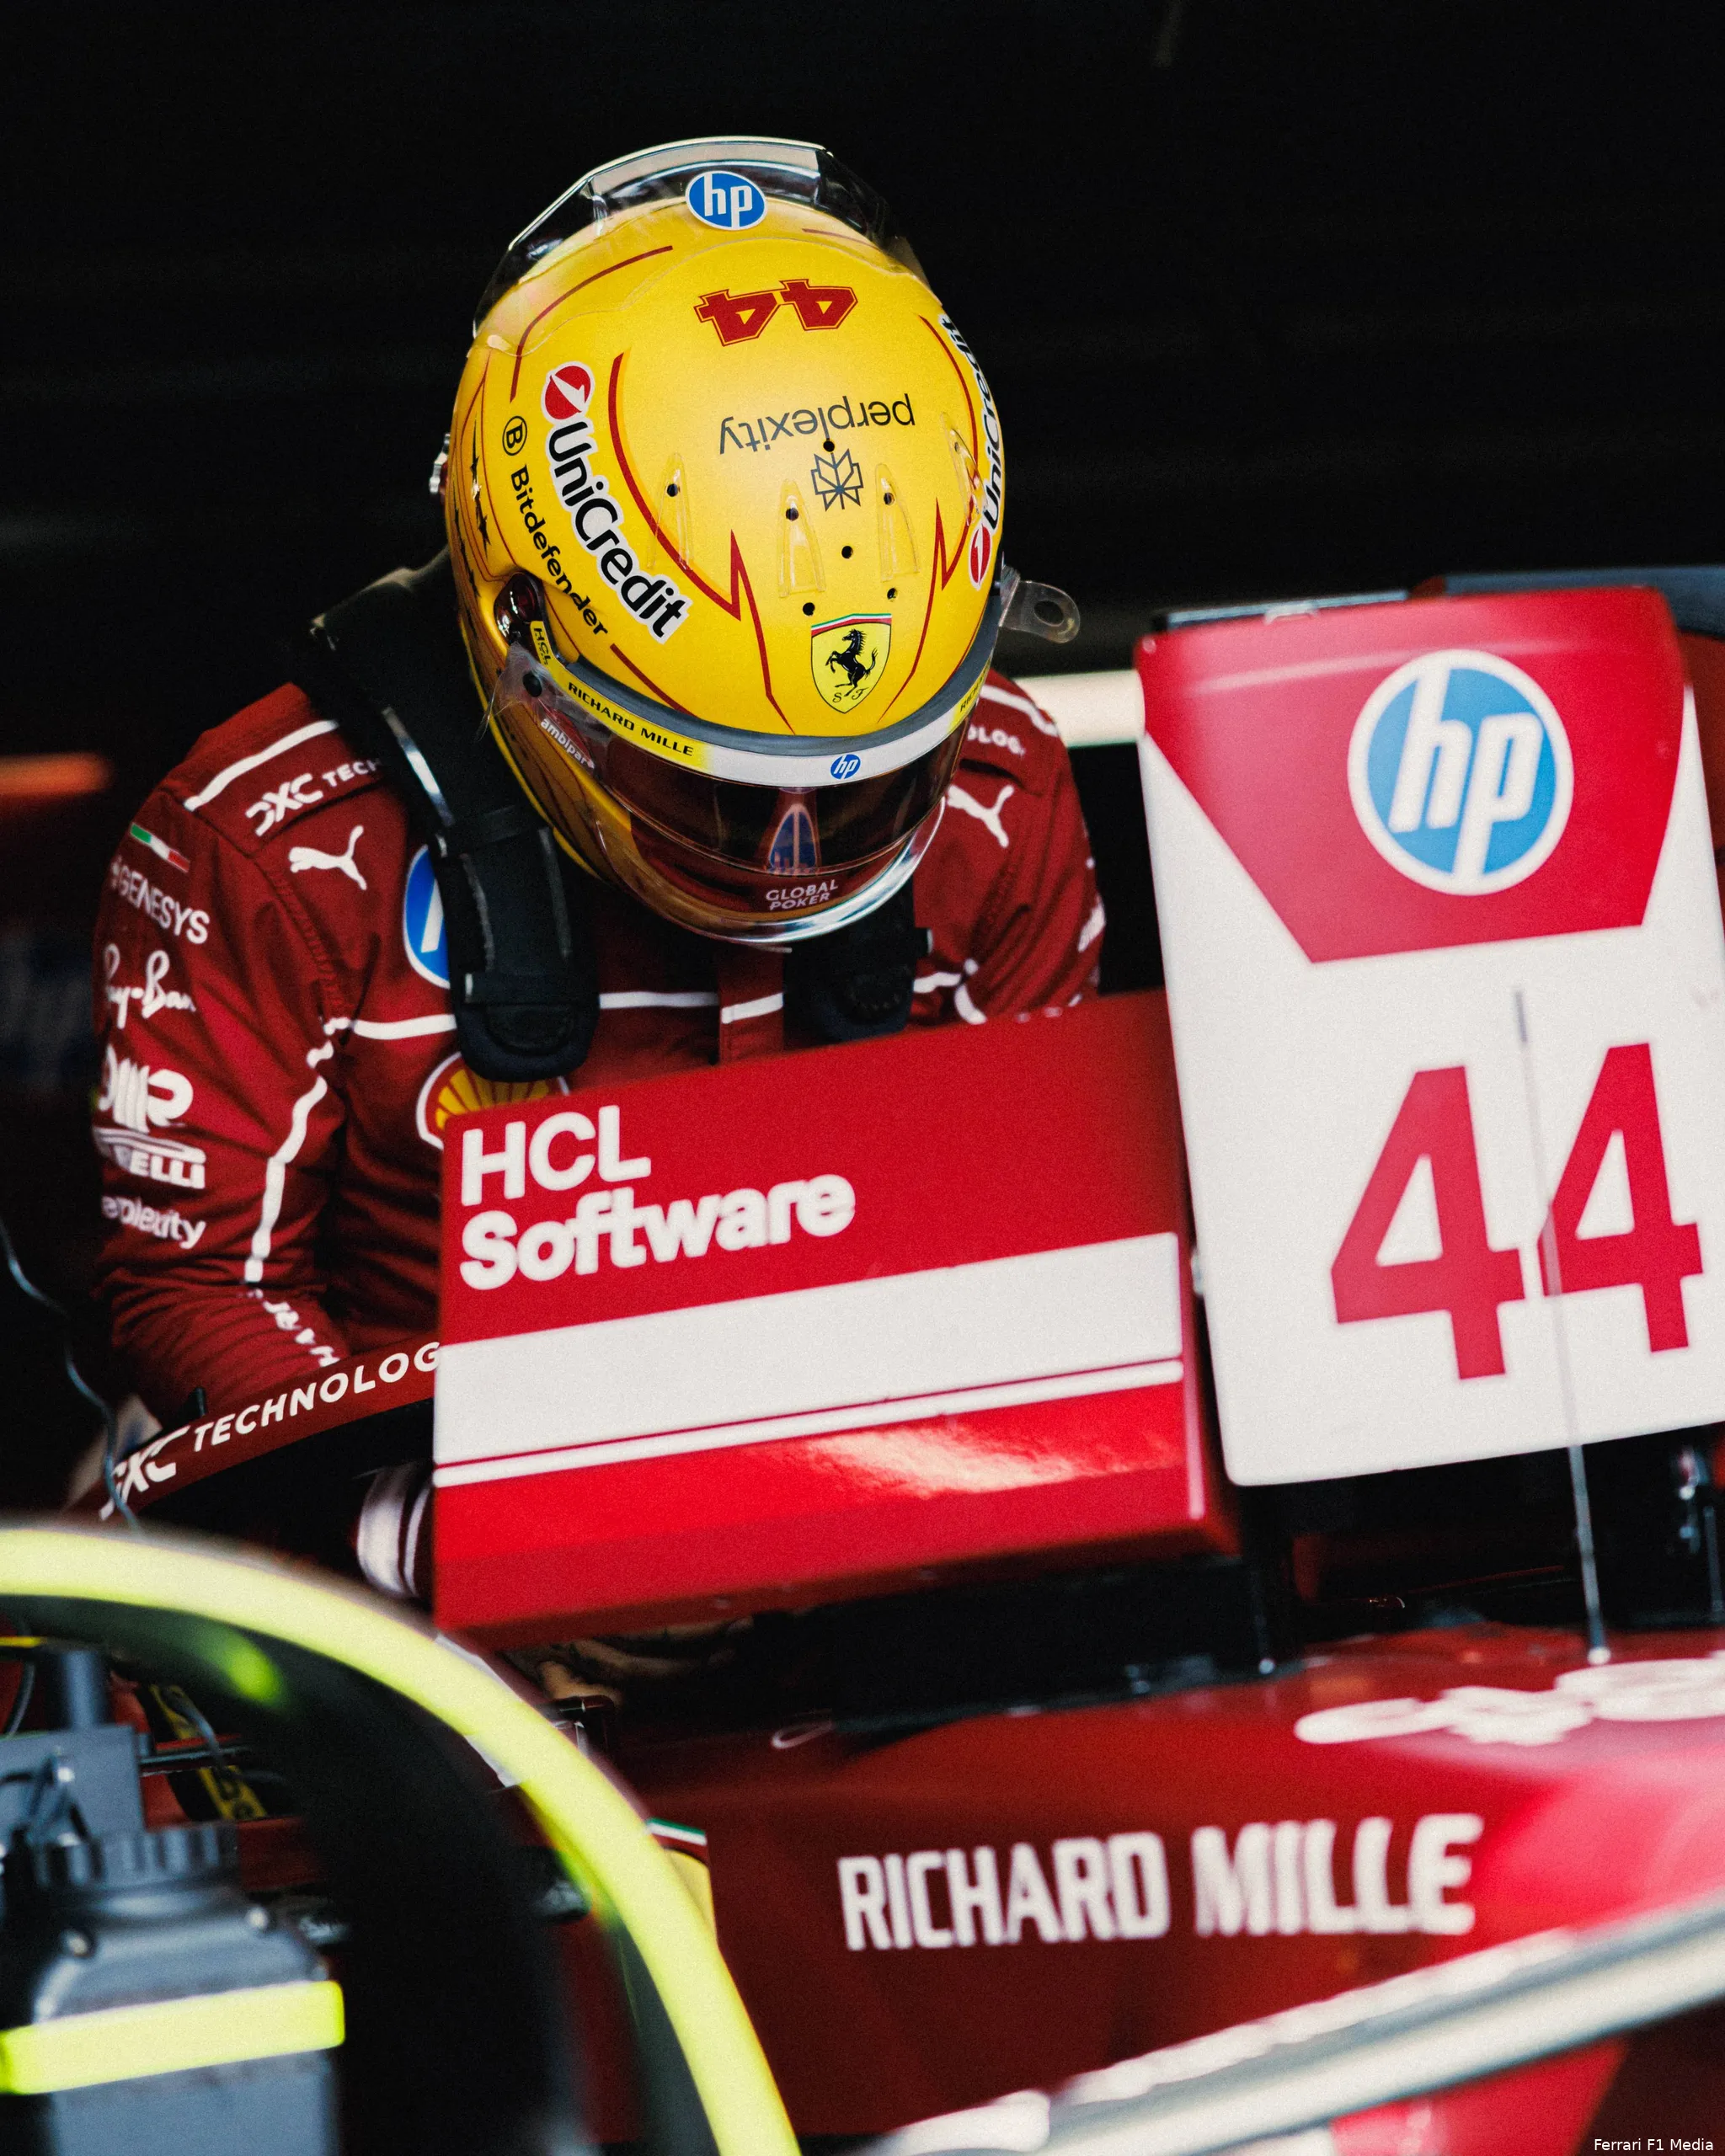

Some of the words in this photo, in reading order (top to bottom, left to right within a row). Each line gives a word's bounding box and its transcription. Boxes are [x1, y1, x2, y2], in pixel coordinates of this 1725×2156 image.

[702, 171, 755, 229] hp
[693, 279, 858, 347] 44
[719, 393, 916, 455] perplexity
[938, 314, 1001, 530] UniCredit
[510, 464, 608, 635] Bitdefender
[549, 421, 683, 638] UniCredit
[540, 718, 588, 764] ambipar
[568, 681, 634, 732] RICHARD
[640, 728, 694, 756] MILLE
[833, 754, 859, 780] hp
[1386, 665, 1544, 883] hp
[766, 878, 839, 901] GLOBAL
[769, 892, 830, 910] POKER
[461, 1105, 652, 1207] HCL
[459, 1174, 856, 1290] Software
[1331, 1042, 1703, 1380] 44
[194, 1342, 440, 1453] TECHNOLOG
[838, 1832, 1171, 1951] RICHARD
[1190, 1812, 1484, 1936] MILLE
